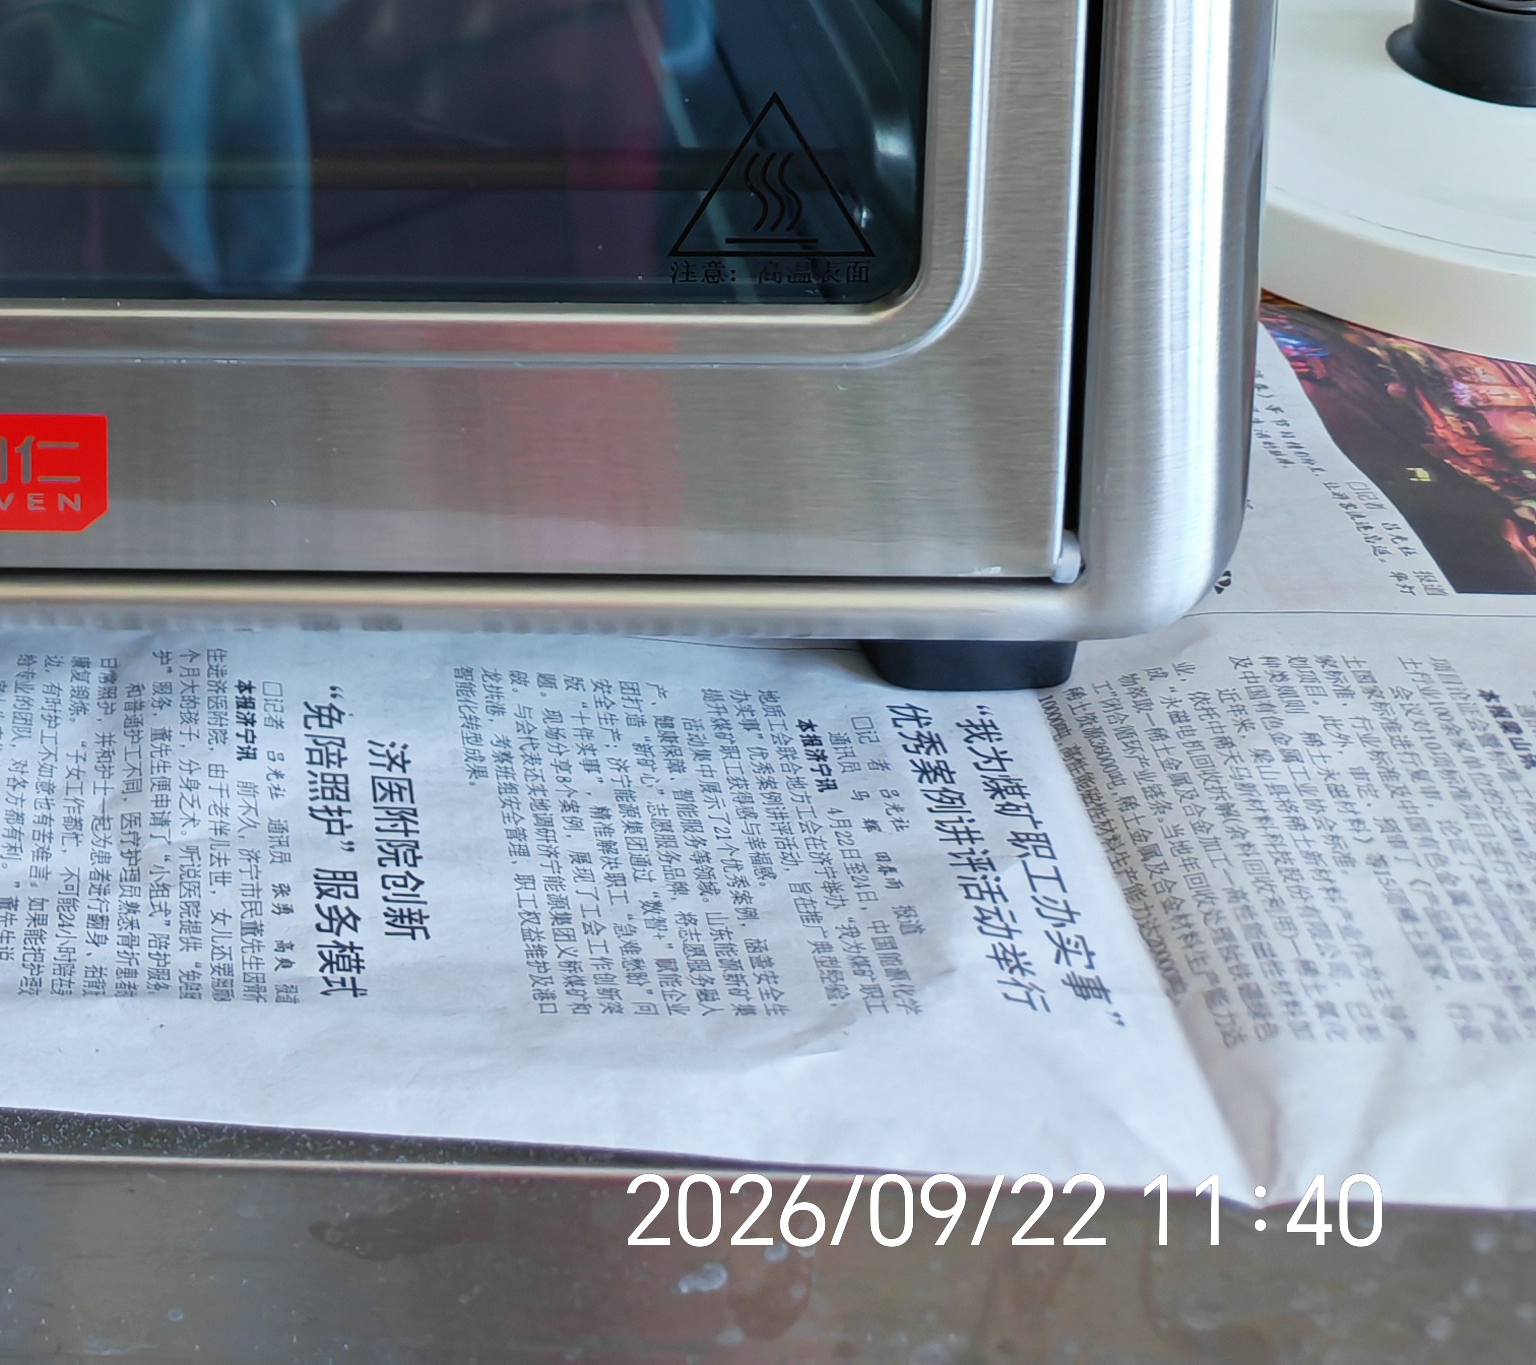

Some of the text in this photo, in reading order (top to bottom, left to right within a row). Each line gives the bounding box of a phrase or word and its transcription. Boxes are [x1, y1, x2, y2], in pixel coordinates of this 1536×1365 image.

[235, 679, 258, 761] 本报济宁讯
[263, 698, 284, 729] 记者
[794, 719, 838, 793] 本报济宁讯
[266, 818, 291, 864] 通讯员
[270, 882, 292, 916] 张勇
[302, 684, 367, 998] “免陪照护”服务模式
[367, 739, 429, 940] 济医附院创新
[826, 731, 863, 774] 通讯员
[890, 905, 927, 936] 报道
[884, 703, 1051, 1013] 优秀案例讲评活动举行
[947, 704, 1125, 1026] “我为煤矿职工办实事”
